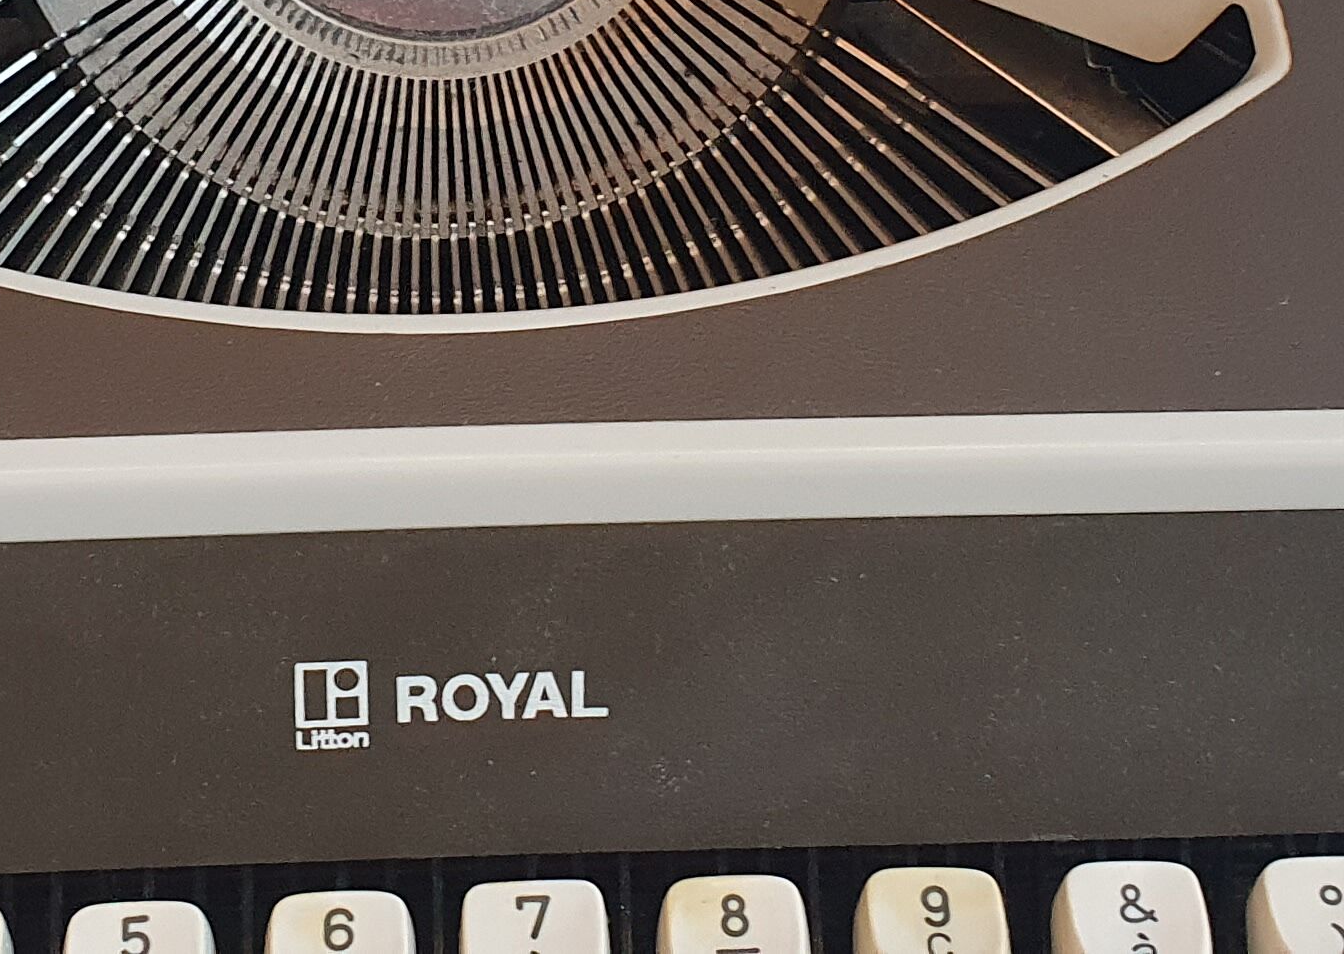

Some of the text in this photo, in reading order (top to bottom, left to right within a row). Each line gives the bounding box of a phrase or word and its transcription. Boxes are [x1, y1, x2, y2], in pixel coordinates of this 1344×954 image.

[396, 670, 610, 724] ROYAL
[295, 730, 370, 750] Litton
[515, 895, 551, 940] 7
[721, 893, 749, 937] 8
[921, 885, 950, 927] 9
[1119, 883, 1158, 923] &
[121, 914, 151, 954] 5
[323, 908, 354, 951] 6
